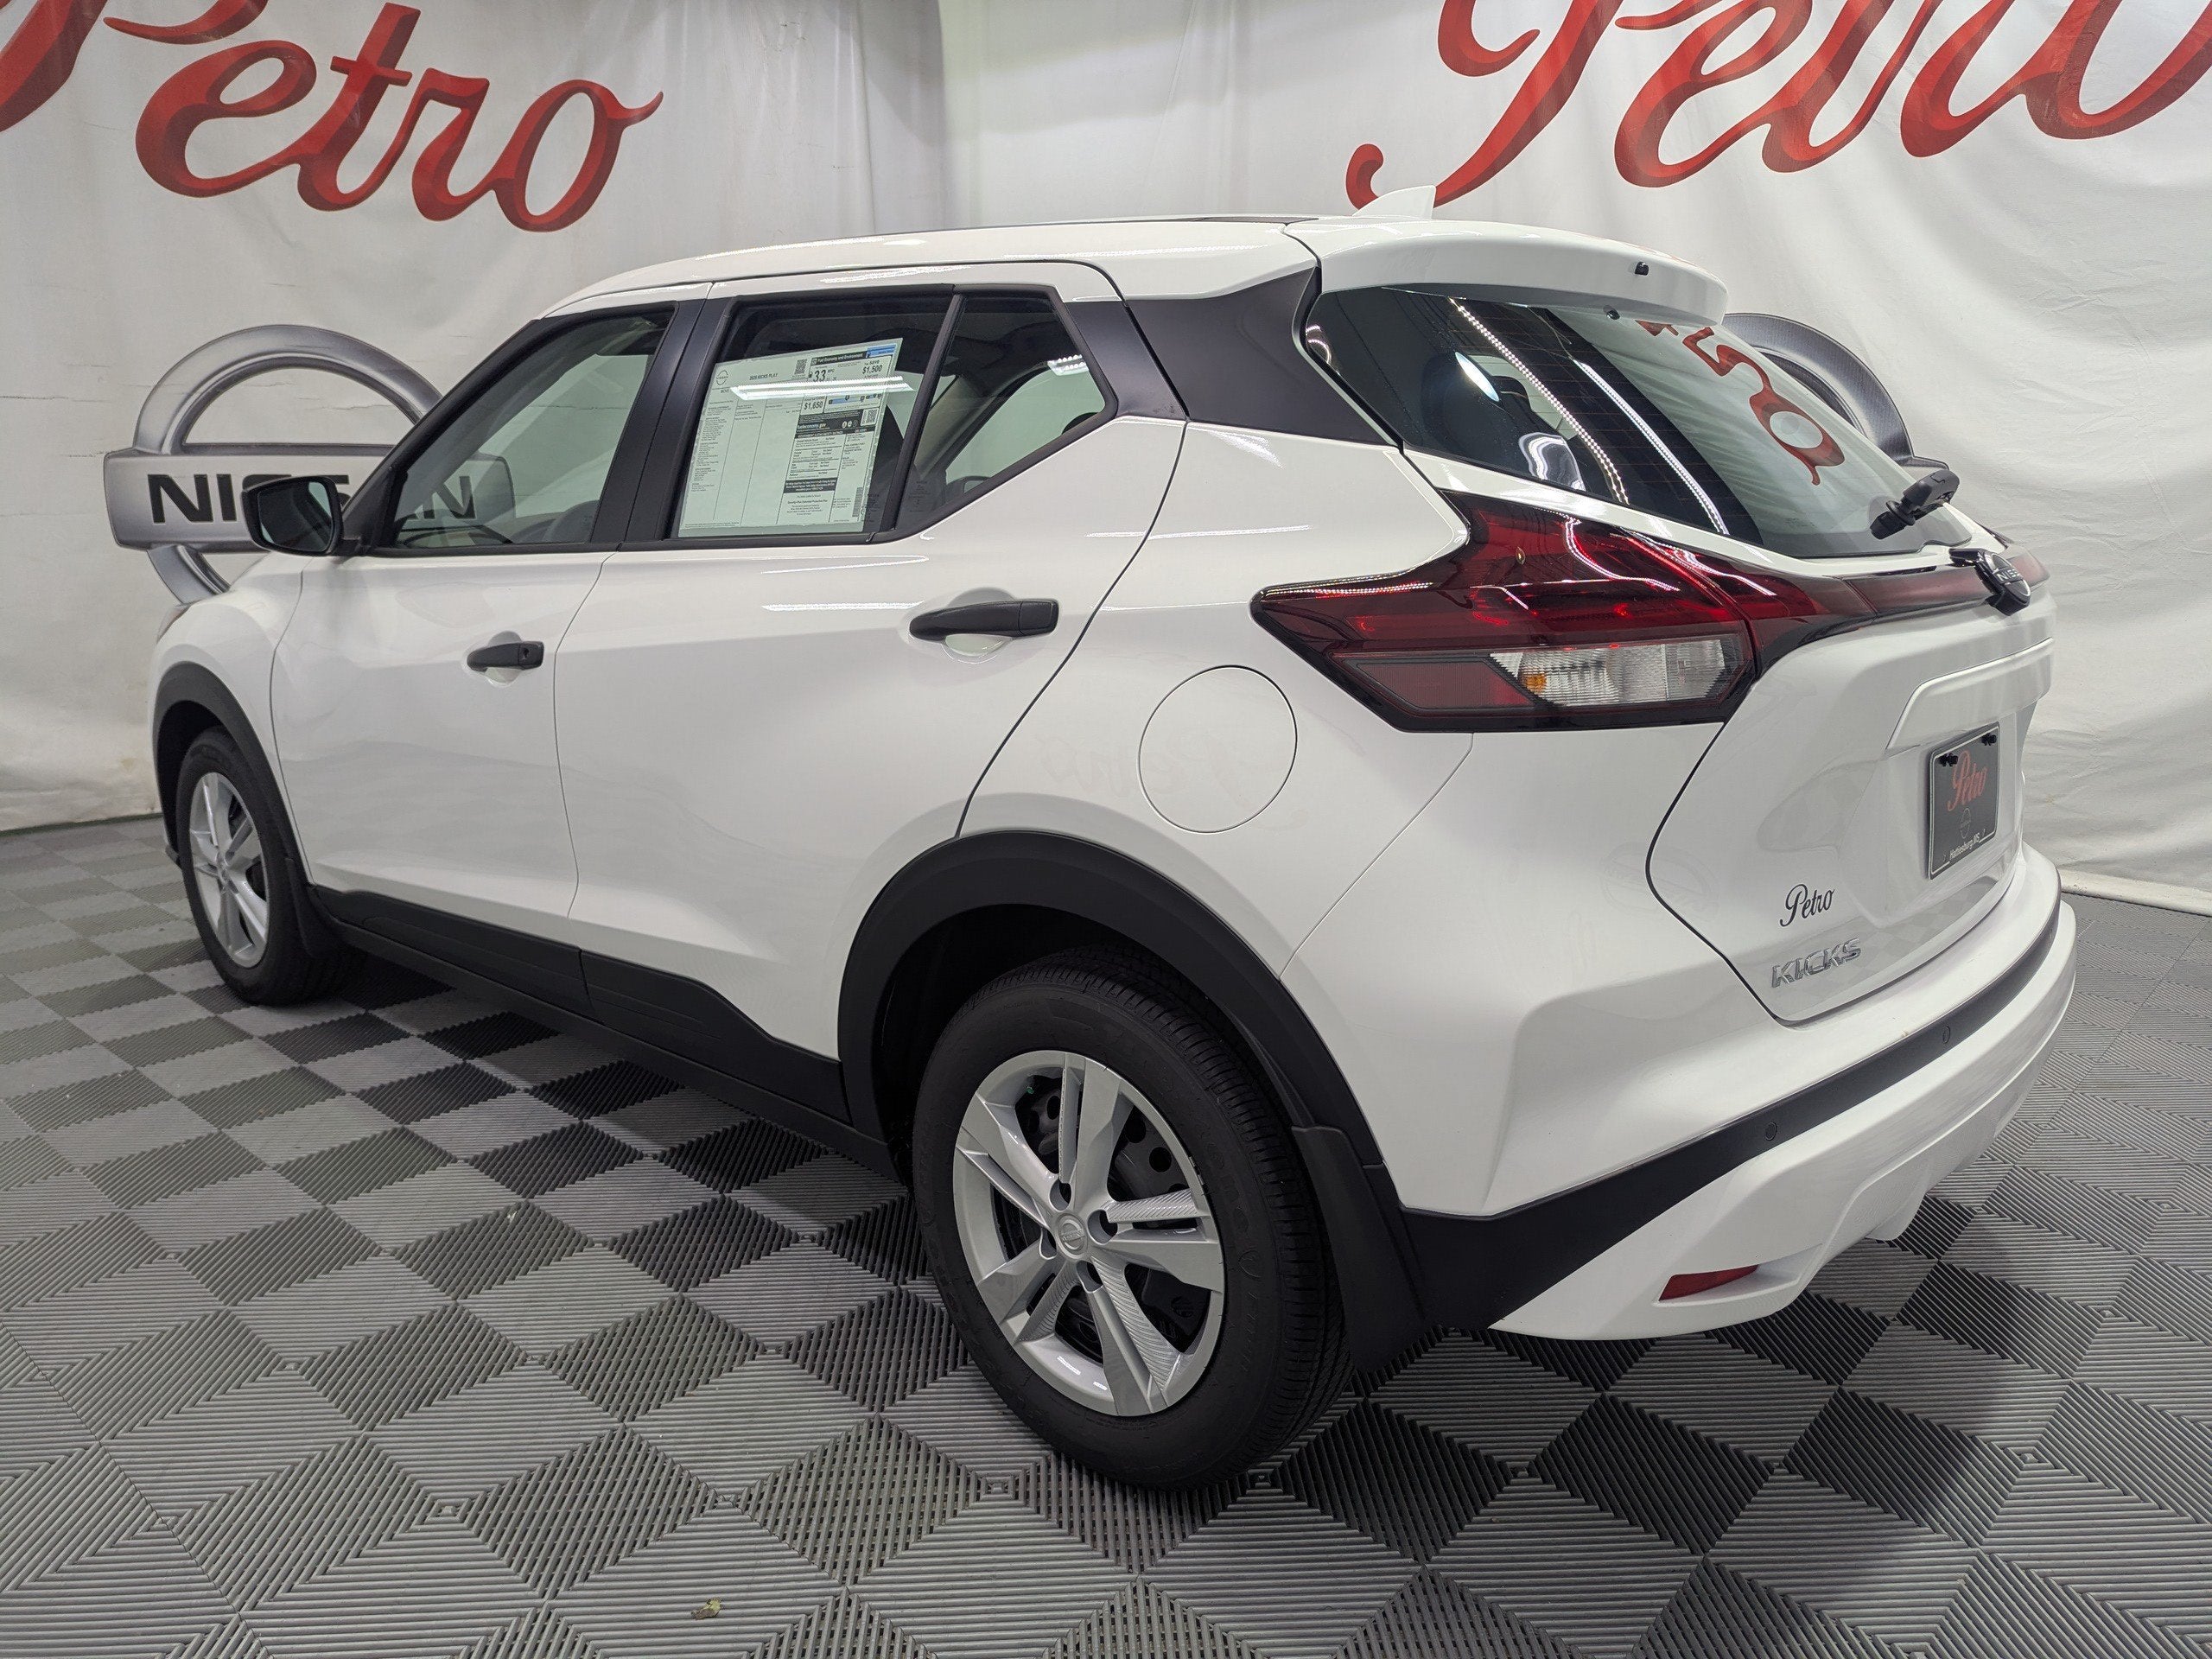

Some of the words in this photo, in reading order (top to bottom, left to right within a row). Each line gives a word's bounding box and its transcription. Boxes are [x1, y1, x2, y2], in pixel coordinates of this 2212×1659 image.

[862, 365, 882, 374] $1,500
[1947, 750, 1987, 811] Petro
[1779, 883, 1835, 927] Petro
[1771, 938, 1862, 988] KICKS
